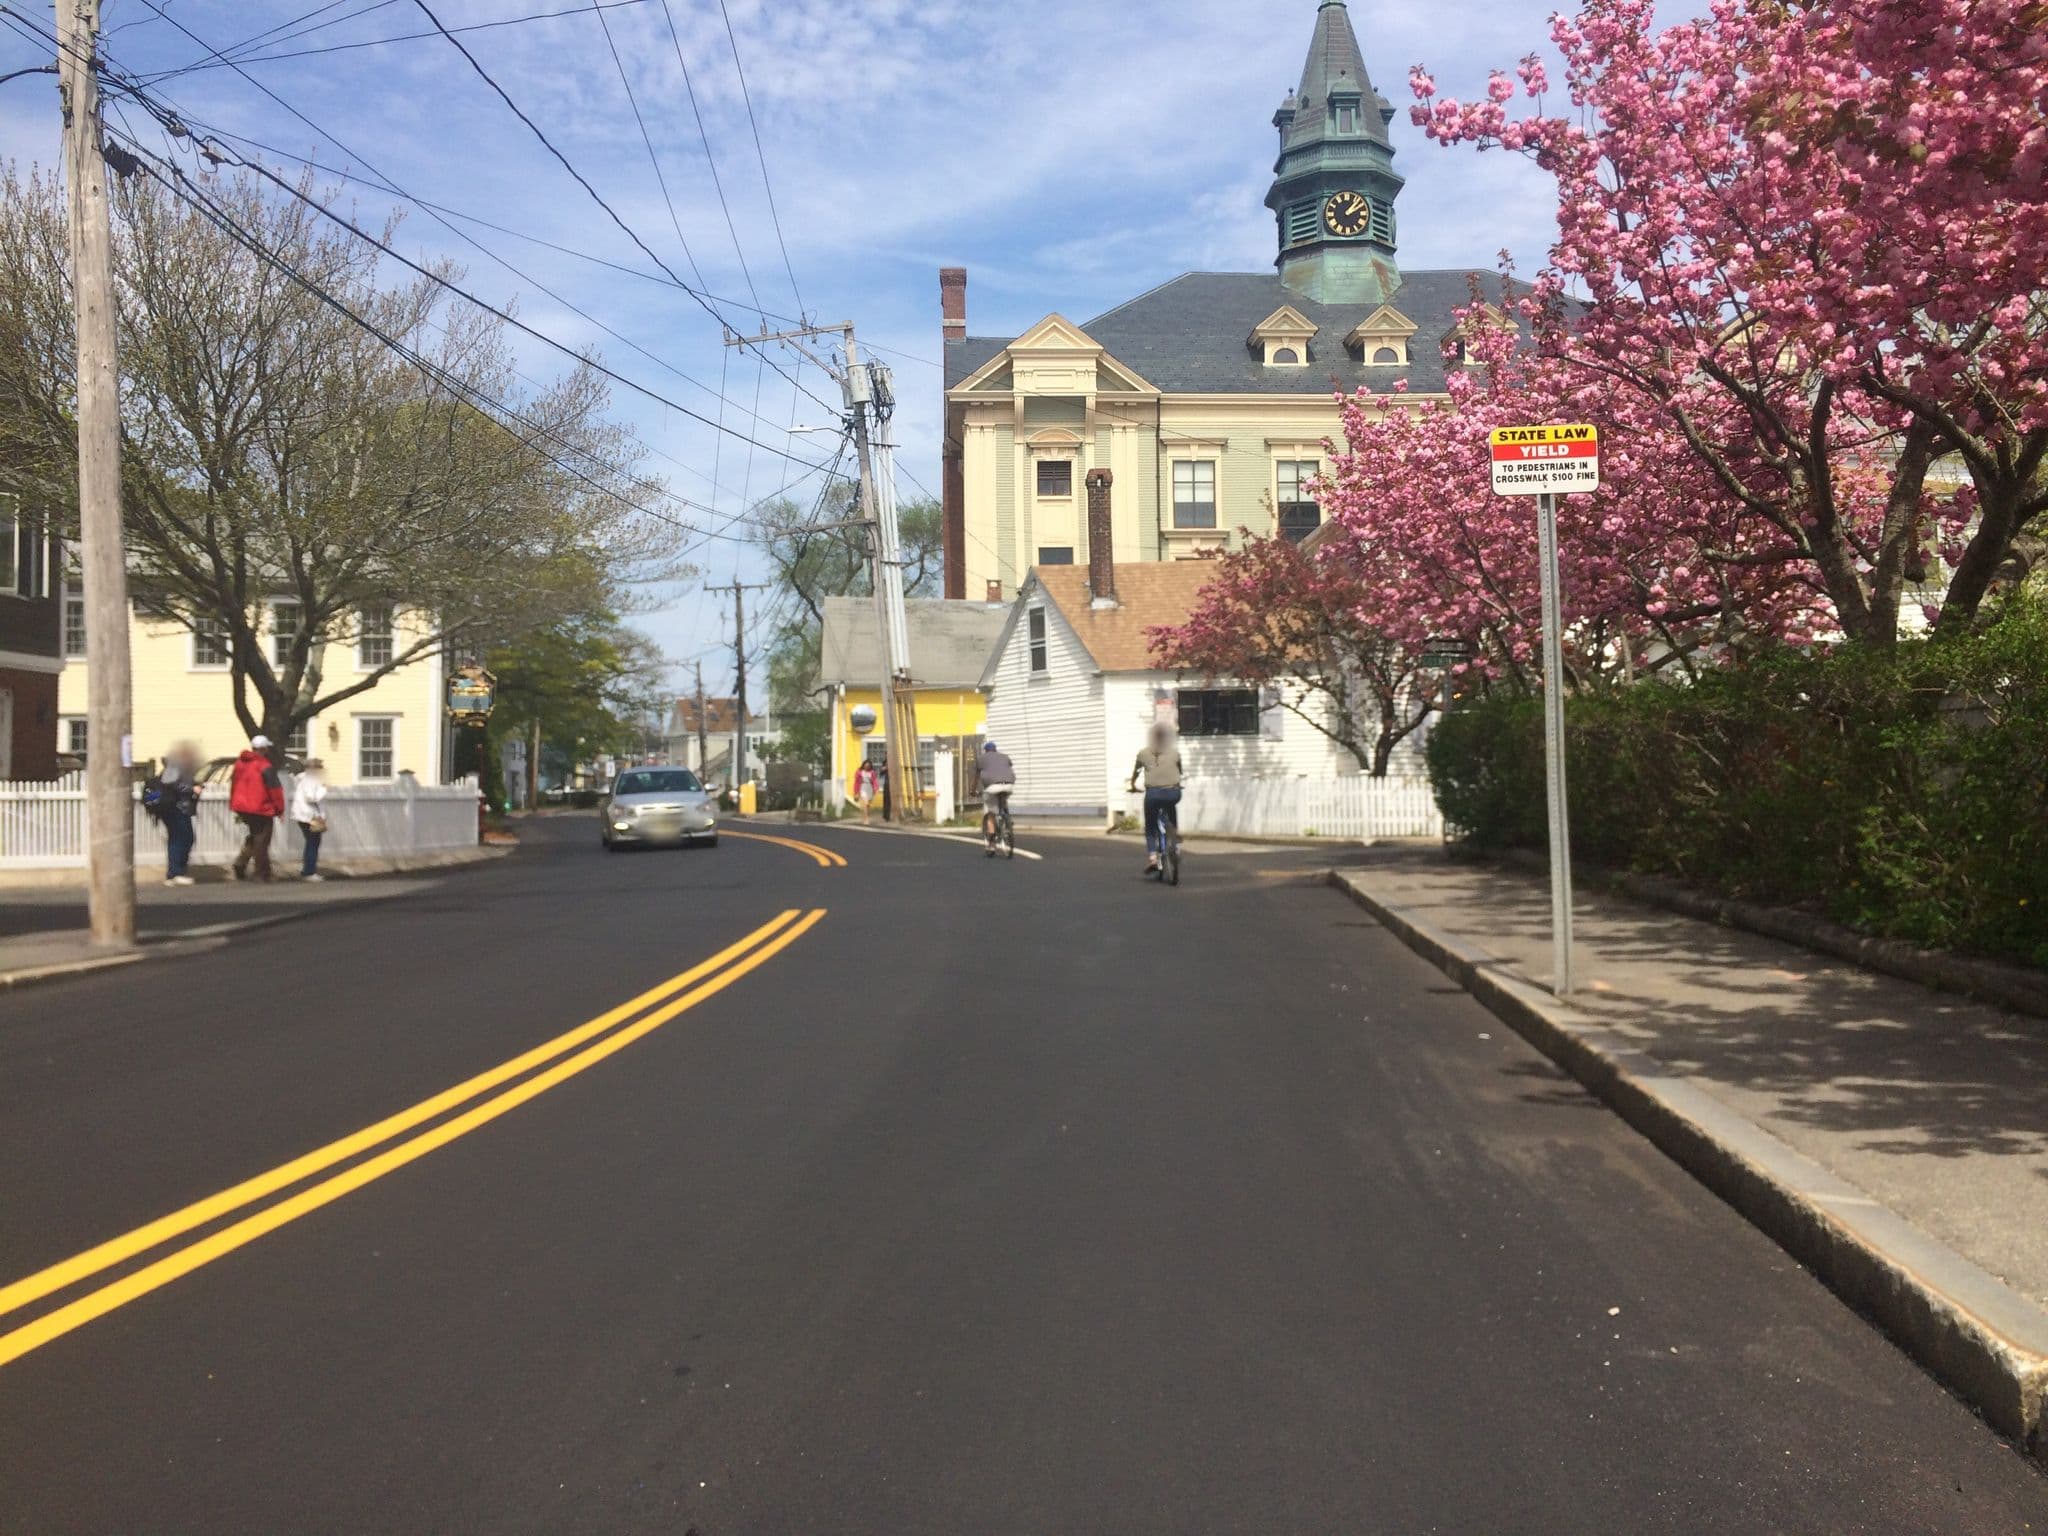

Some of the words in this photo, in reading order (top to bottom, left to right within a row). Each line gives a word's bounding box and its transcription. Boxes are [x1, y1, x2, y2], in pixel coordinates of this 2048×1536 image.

[1499, 430, 1546, 441] STATE
[1554, 428, 1588, 439] LAW
[1520, 445, 1569, 457] YIELD
[1502, 464, 1513, 472] TO
[1517, 462, 1576, 471] PEDESTRIANS
[1579, 461, 1588, 469] IN
[1496, 474, 1548, 483] CROSSWALK
[1552, 472, 1573, 481] $100
[1576, 472, 1595, 480] FINE
